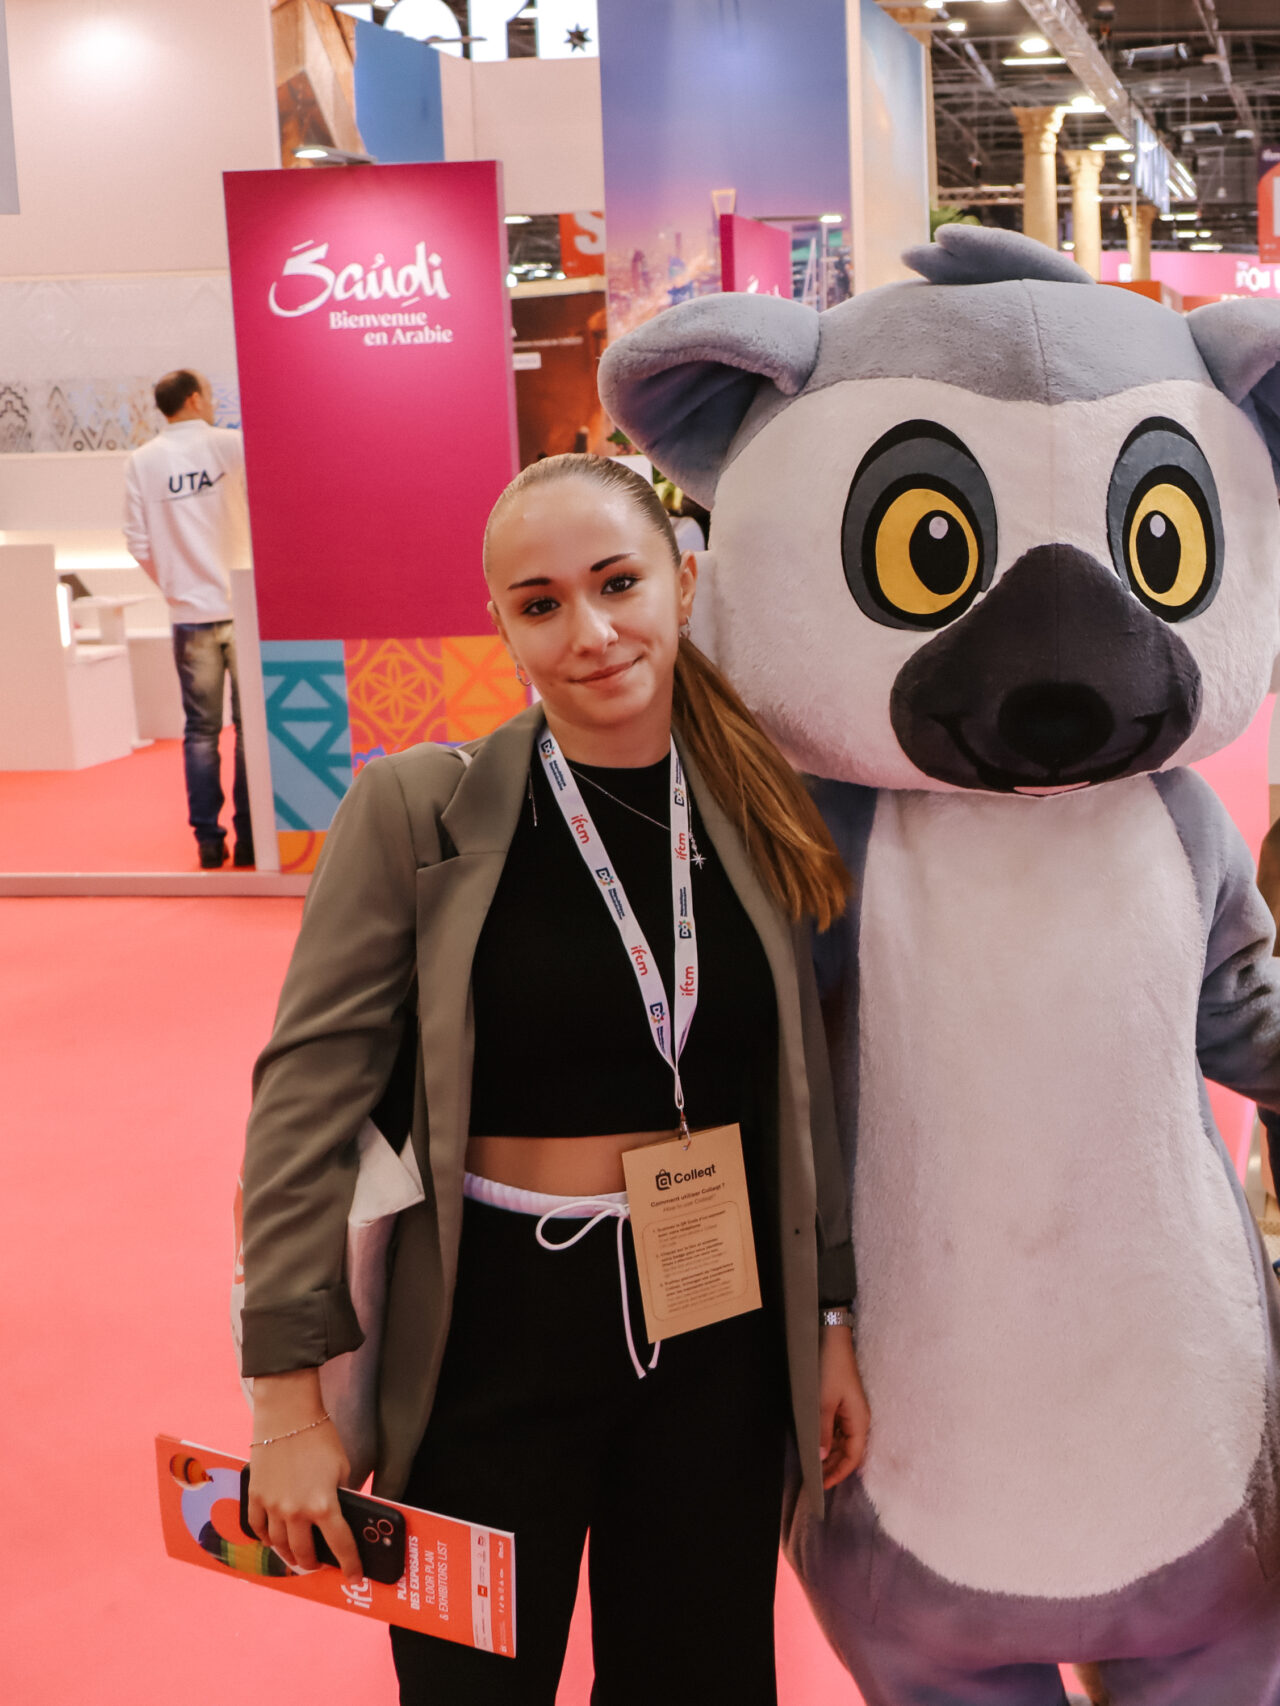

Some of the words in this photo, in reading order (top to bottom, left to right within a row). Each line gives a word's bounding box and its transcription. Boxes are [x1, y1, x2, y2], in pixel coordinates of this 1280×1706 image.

[329, 311, 428, 329] Bienvenue
[364, 332, 389, 346] en
[392, 324, 453, 345] Arabie
[169, 469, 213, 493] UTA
[571, 814, 590, 844] iftm
[674, 833, 688, 861] iftm
[631, 944, 648, 976] iftm
[680, 966, 696, 996] iftm
[674, 1164, 717, 1185] Colleqt
[409, 1535, 419, 1590] EXPOSANTS
[424, 1550, 435, 1575] PLAN
[437, 1540, 448, 1560] LIST
[340, 1577, 373, 1609] ift
[397, 1576, 407, 1601] PLA
[410, 1590, 420, 1610] DES
[425, 1577, 435, 1605] FLOOR
[438, 1562, 449, 1613] EXHIBITORS
